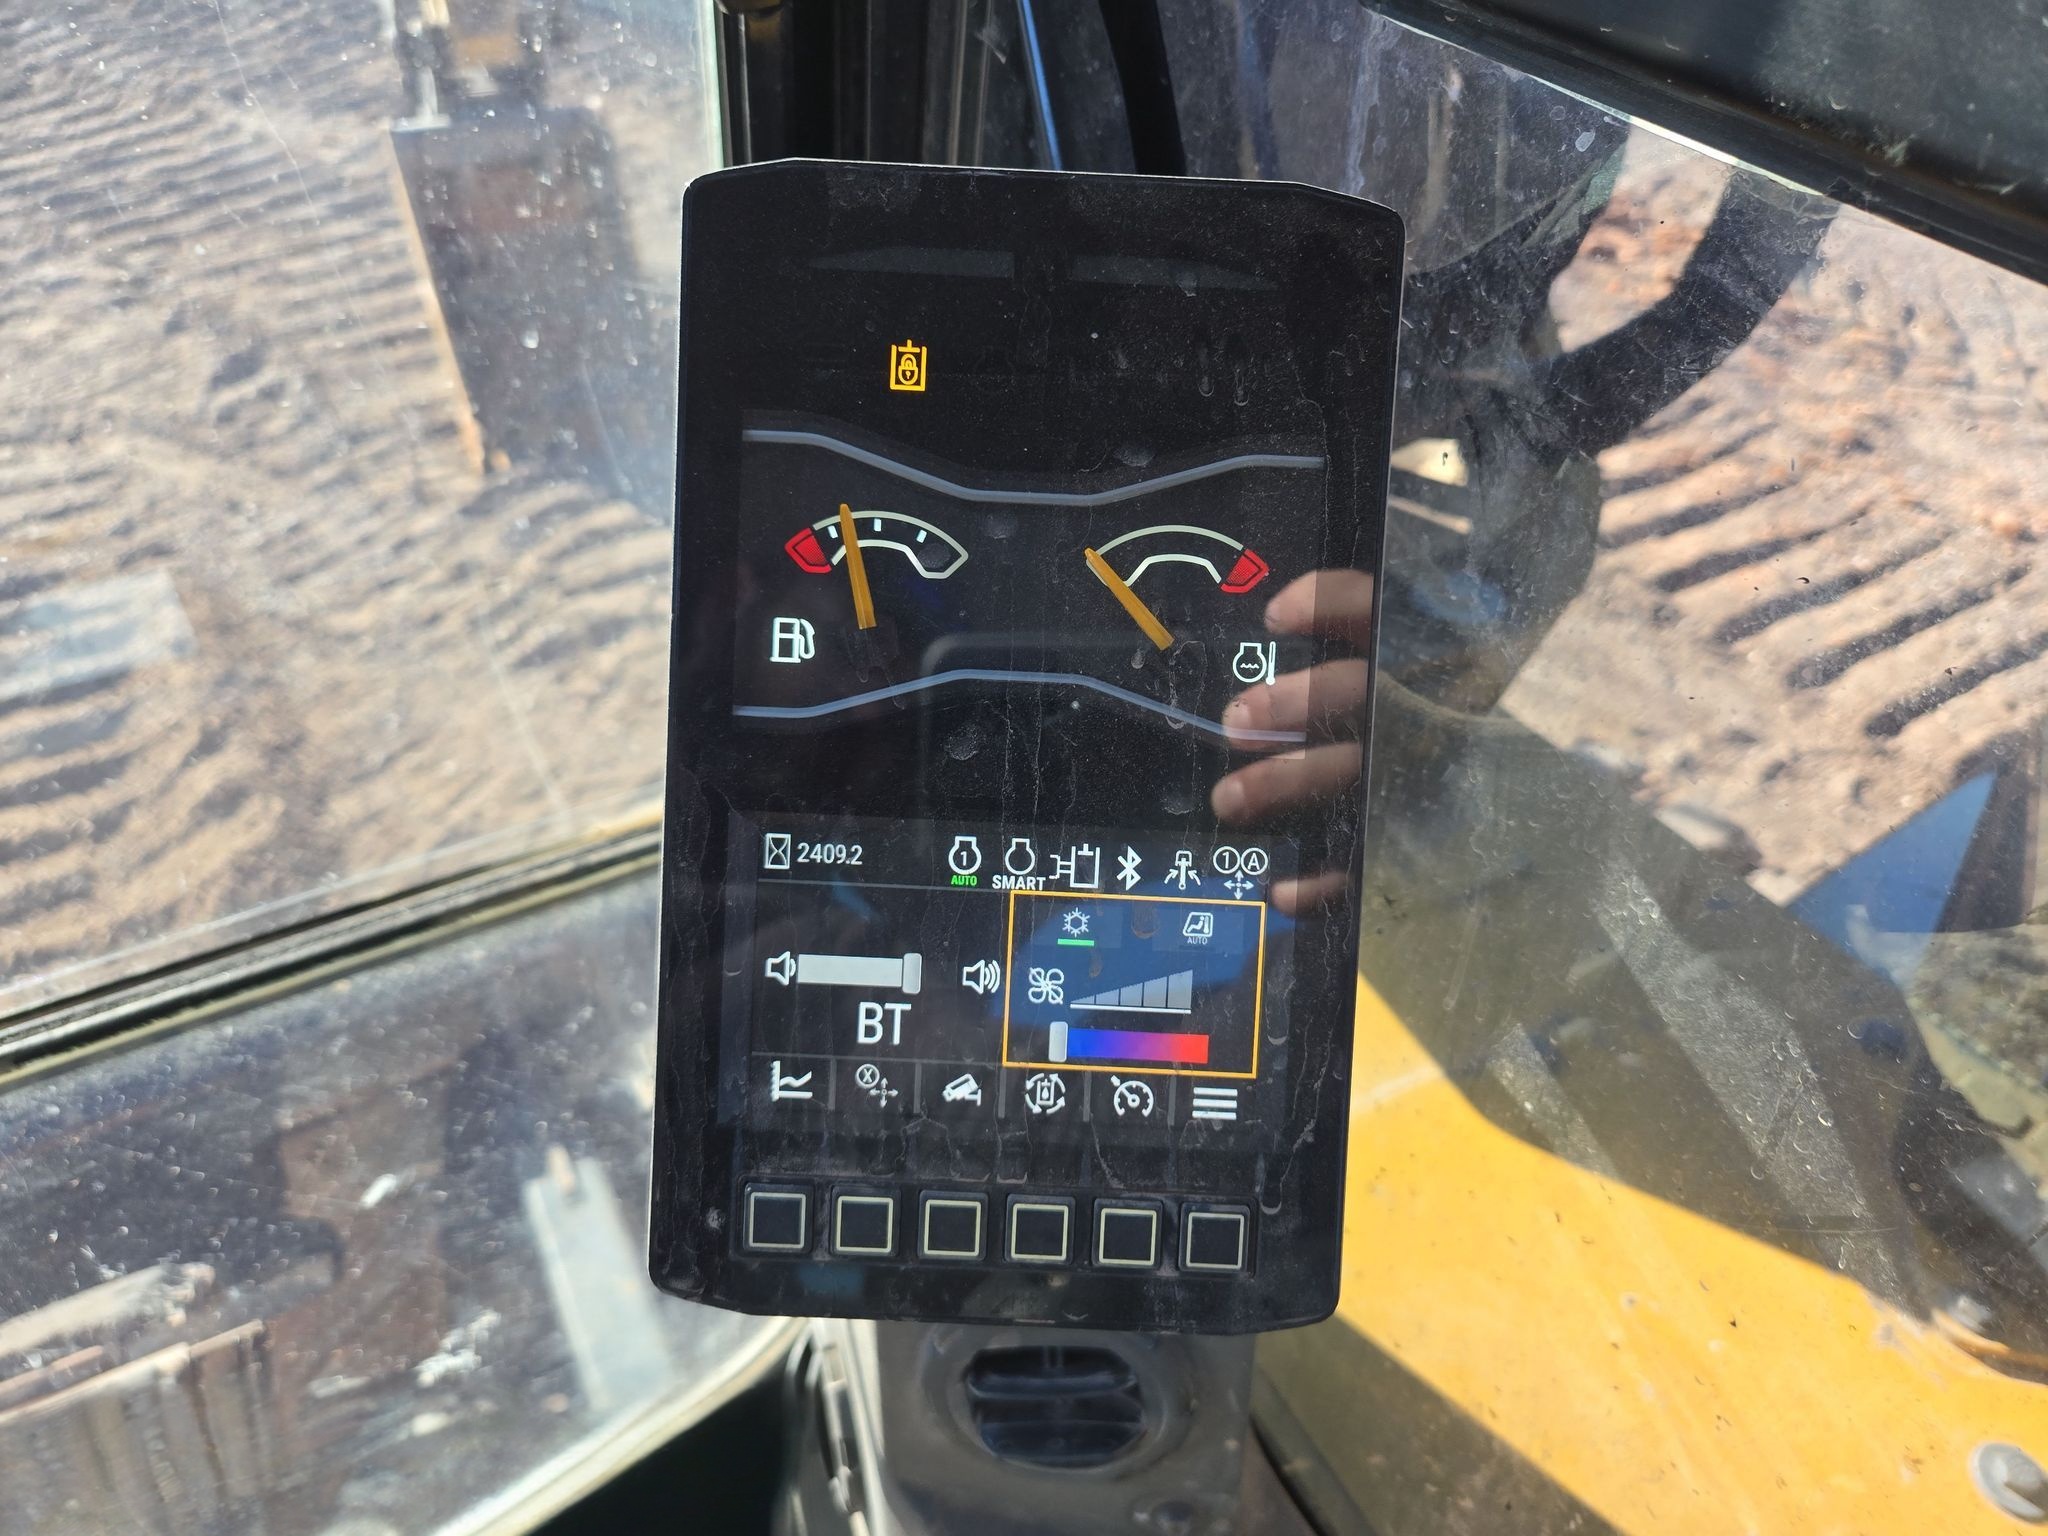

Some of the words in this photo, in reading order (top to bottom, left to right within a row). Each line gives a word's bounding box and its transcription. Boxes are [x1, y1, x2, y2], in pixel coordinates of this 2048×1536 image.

[797, 843, 863, 865] 2409.2
[960, 851, 967, 867] 1
[1222, 852, 1230, 869] 1
[1248, 854, 1260, 870] A
[951, 875, 978, 887] AUTO
[992, 875, 1046, 891] SMART
[1187, 936, 1208, 945] AUTO
[857, 1001, 912, 1045] BT
